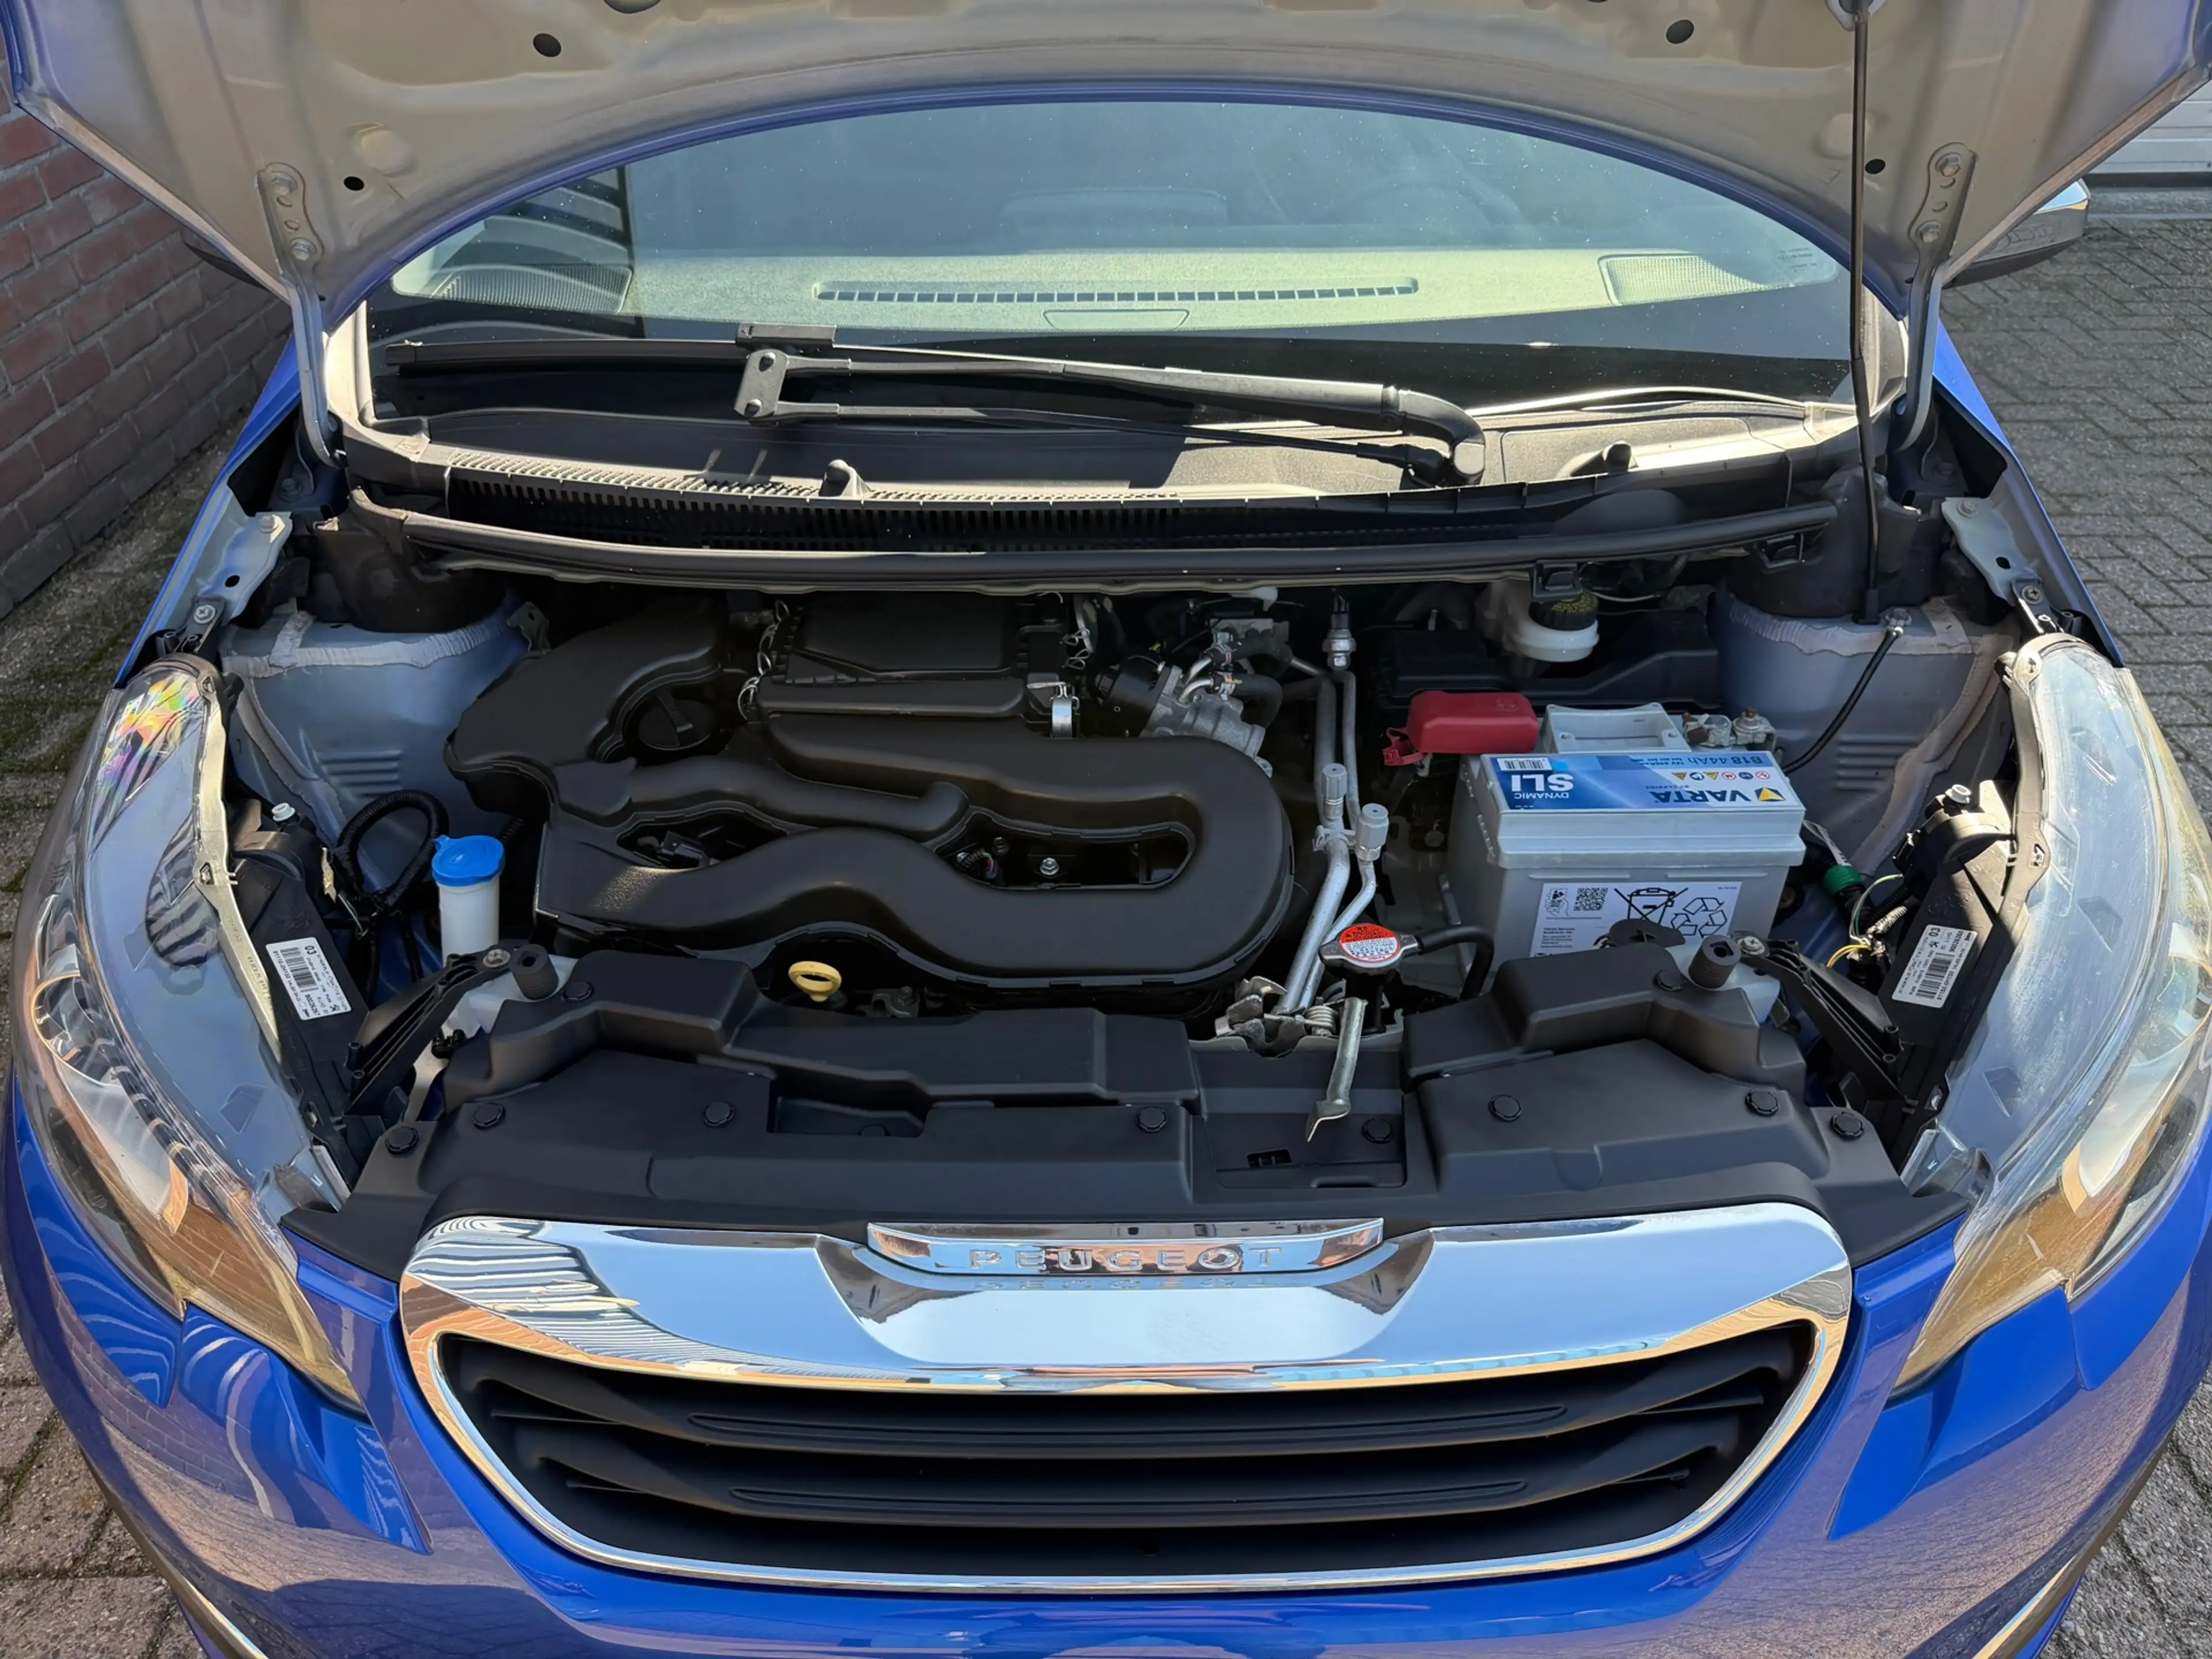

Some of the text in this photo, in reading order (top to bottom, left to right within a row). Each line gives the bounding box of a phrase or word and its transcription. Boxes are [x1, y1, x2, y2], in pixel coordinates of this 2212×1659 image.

[1730, 756, 1763, 764] B18
[1511, 774, 1574, 791] SLI
[1649, 790, 1752, 803] VARTA
[1928, 927, 1941, 937] 03
[304, 945, 317, 955] 03
[969, 1247, 1283, 1271] PEUGEOT
